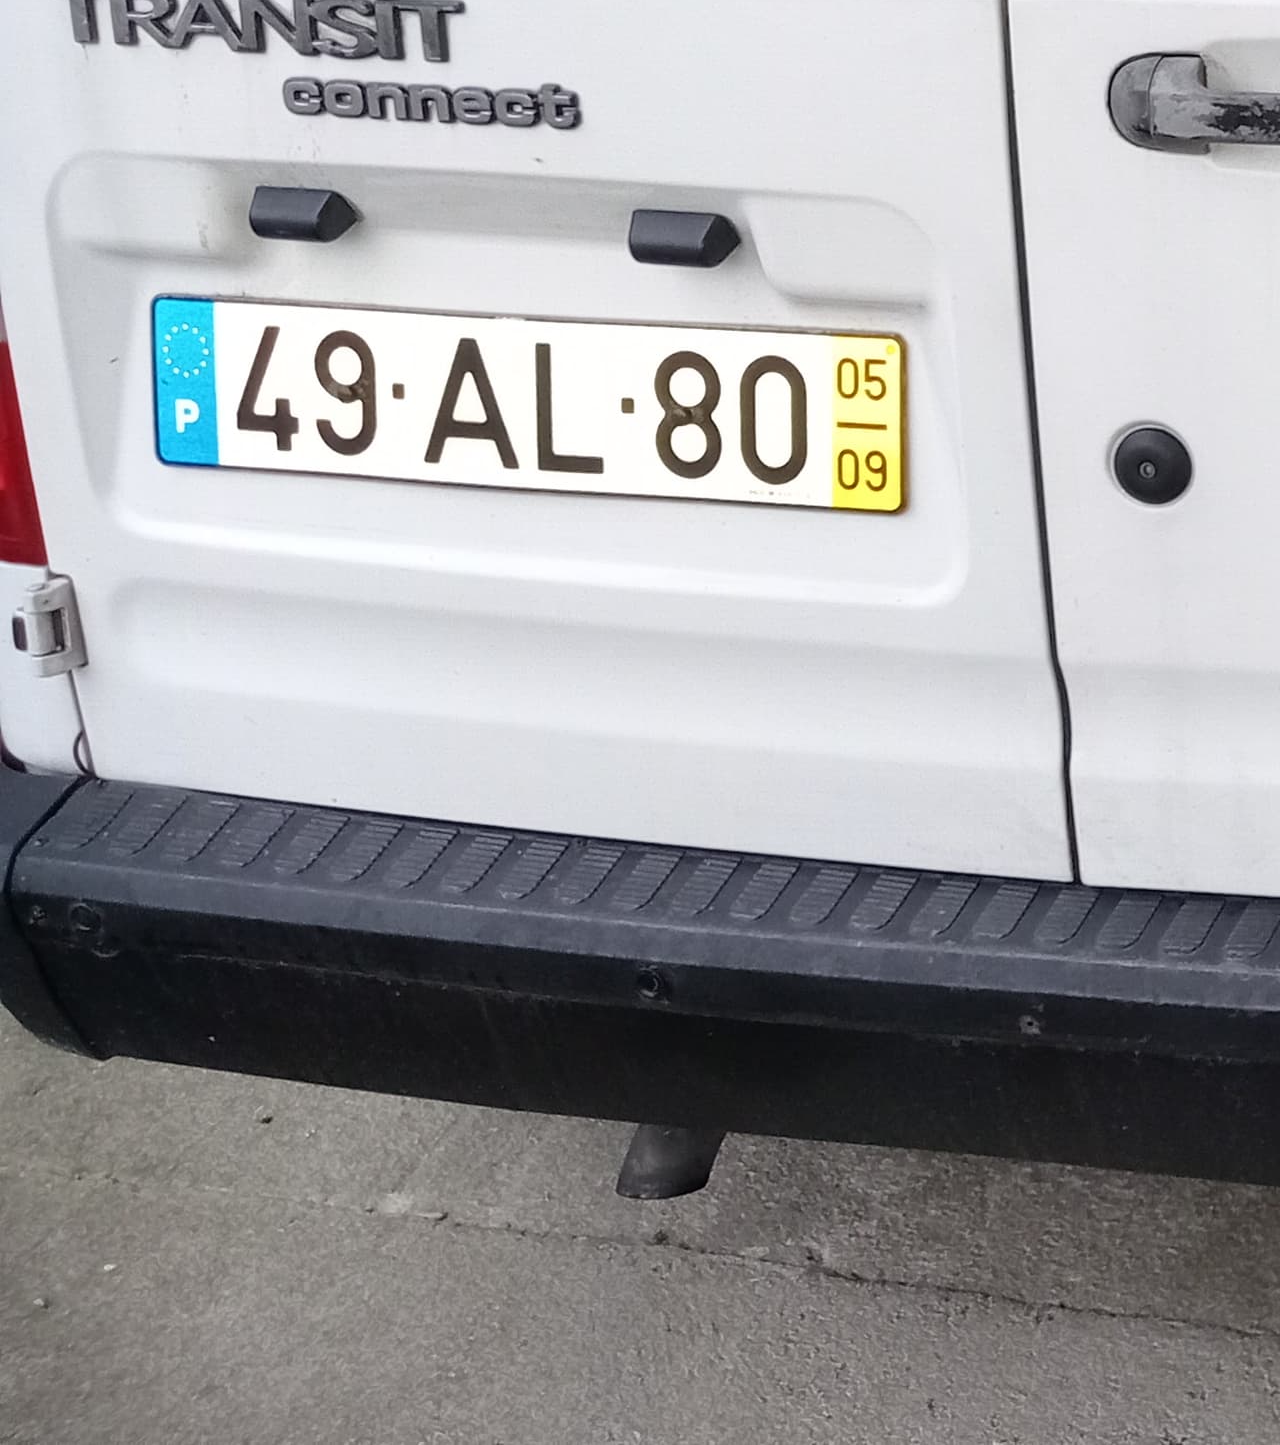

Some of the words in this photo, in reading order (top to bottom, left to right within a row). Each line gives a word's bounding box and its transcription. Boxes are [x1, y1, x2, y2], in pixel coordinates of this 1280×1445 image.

[282, 76, 583, 130] connect
[836, 357, 888, 401] 05
[175, 398, 200, 434] P
[836, 448, 888, 492] 09
